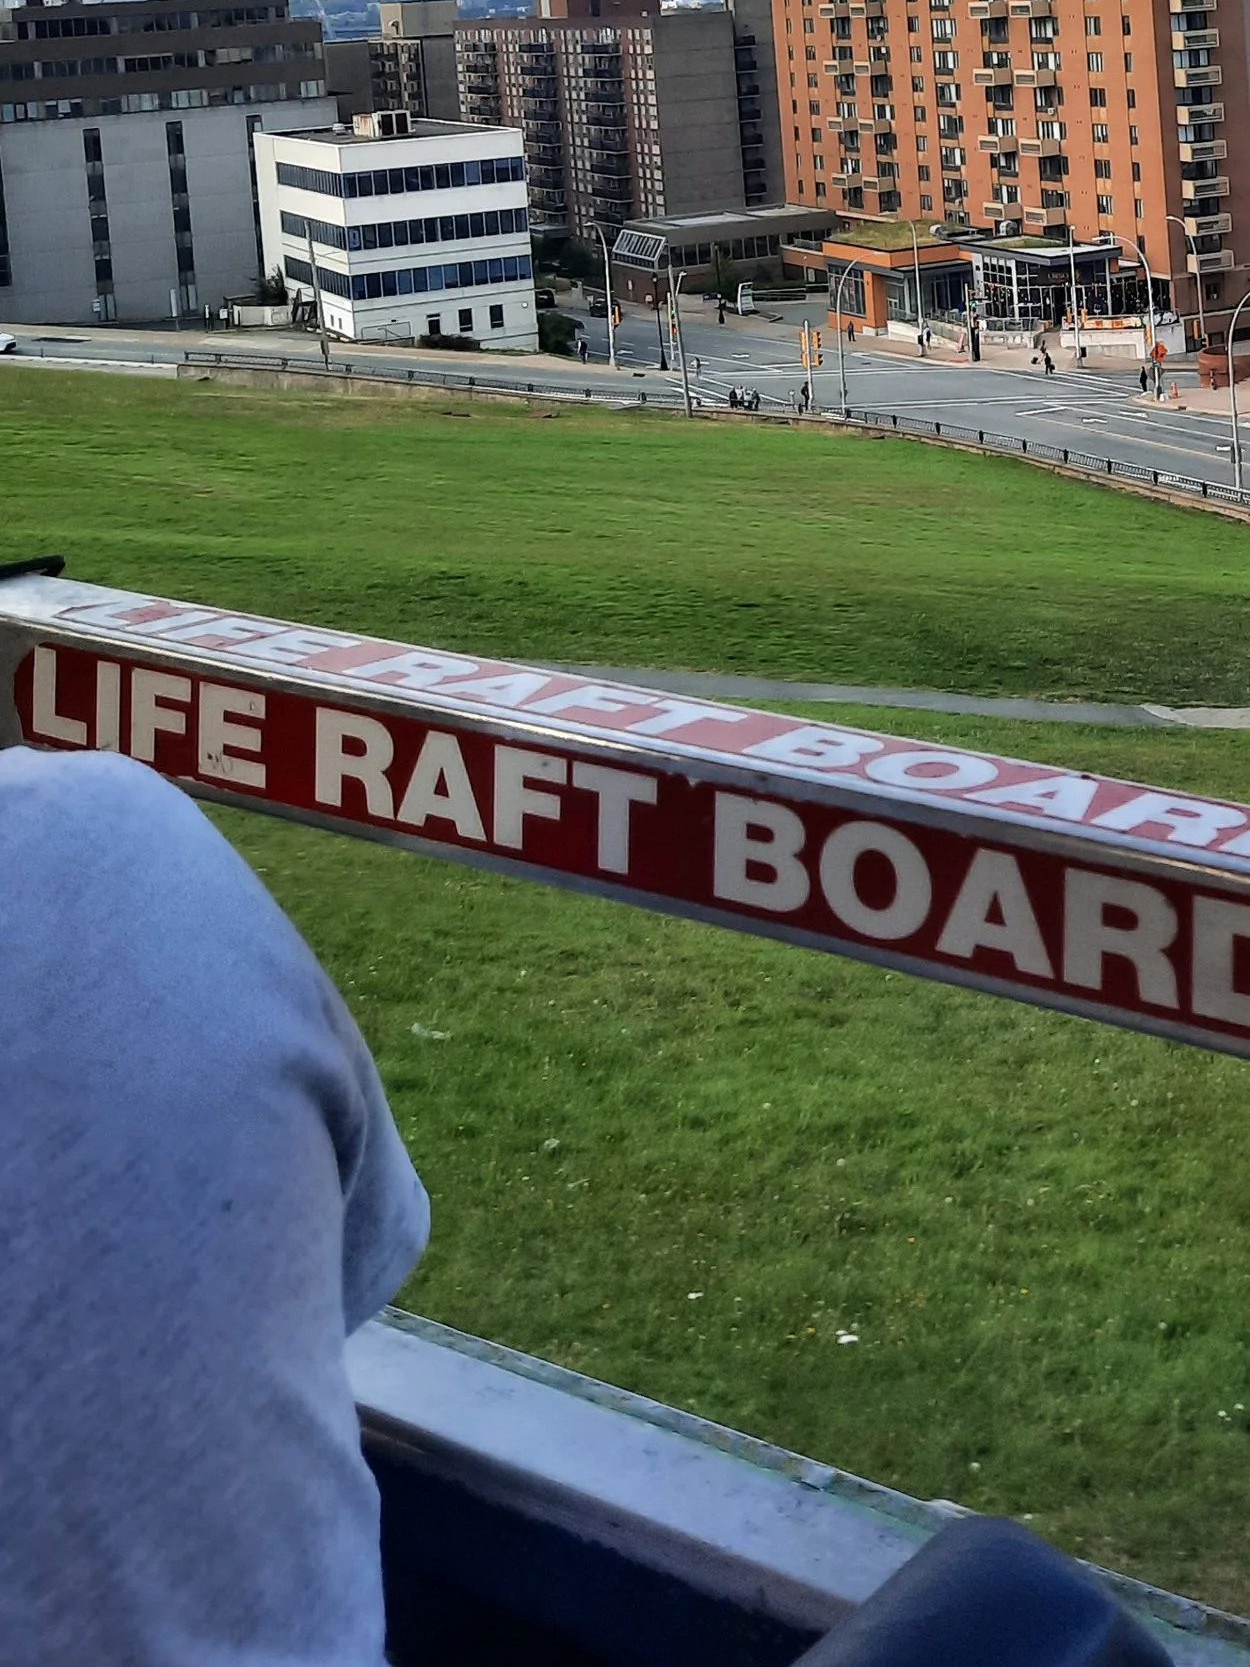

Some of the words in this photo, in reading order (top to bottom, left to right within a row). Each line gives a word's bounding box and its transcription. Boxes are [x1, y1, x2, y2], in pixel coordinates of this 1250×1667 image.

[62, 599, 362, 665] LIFE
[342, 652, 748, 736] RAFT
[33, 645, 266, 789] LIFE
[316, 707, 658, 875] RAFT
